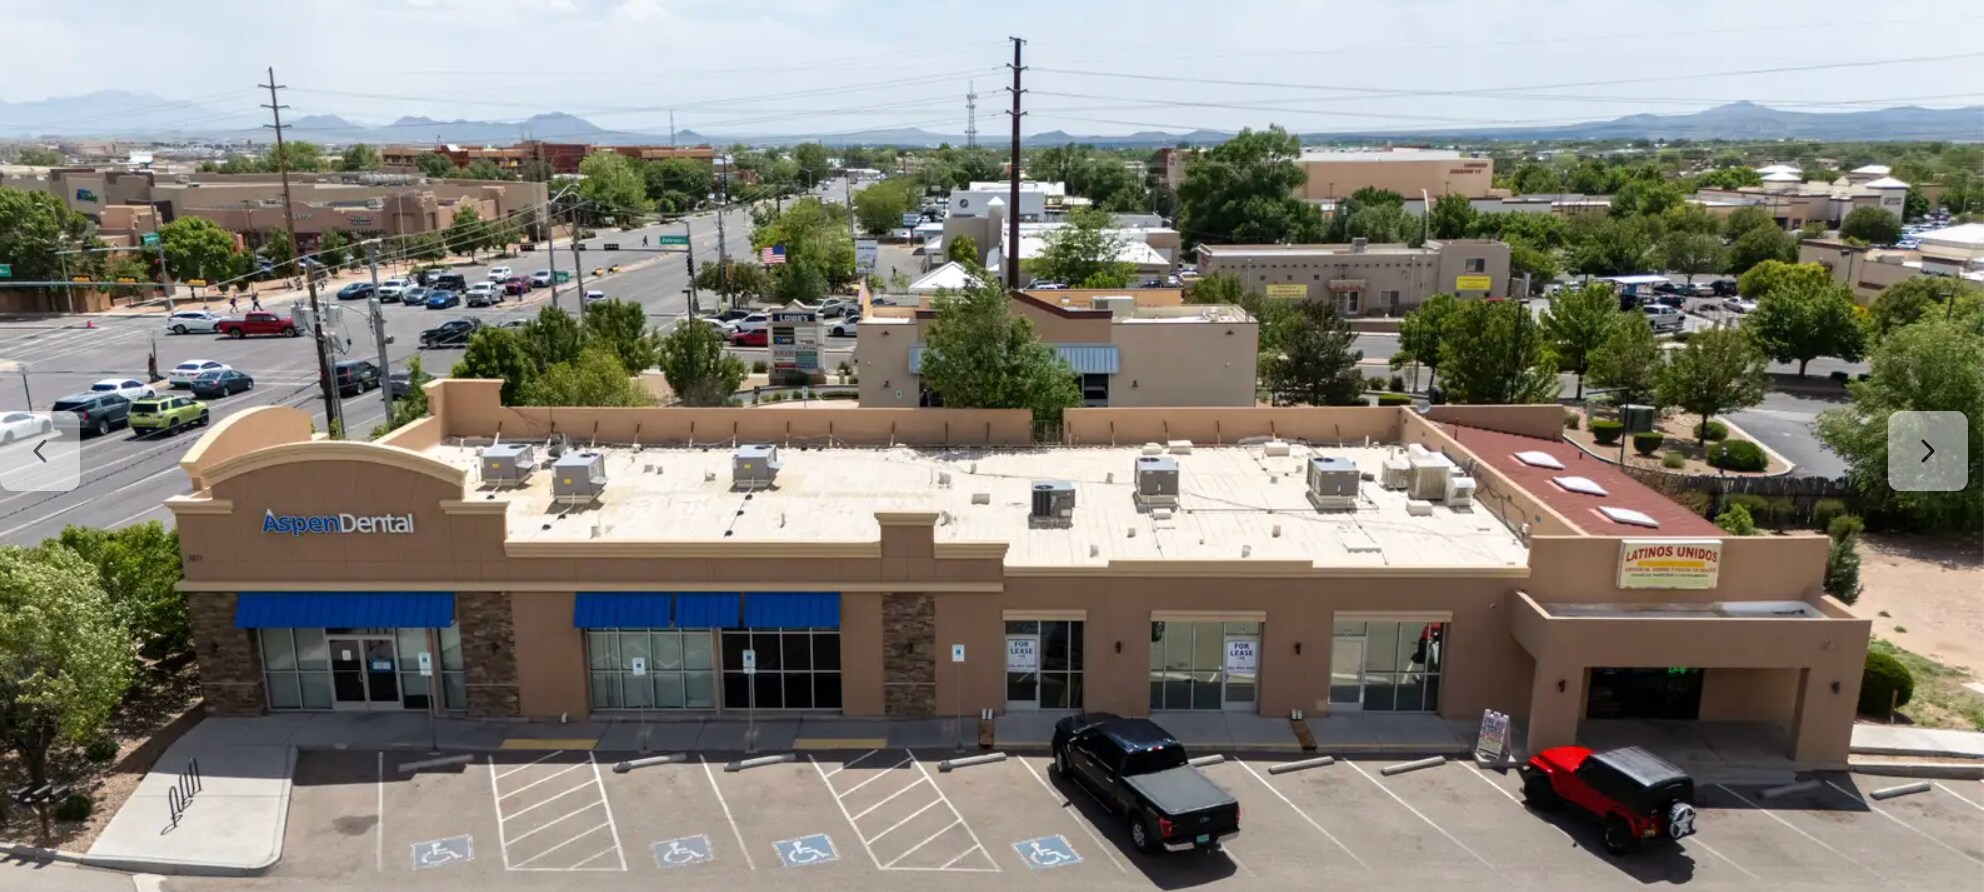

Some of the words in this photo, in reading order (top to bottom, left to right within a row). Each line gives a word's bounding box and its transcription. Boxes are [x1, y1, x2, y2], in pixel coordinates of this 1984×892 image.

[261, 508, 415, 537] AspenDental
[1625, 545, 1674, 563] LATINOS
[1676, 546, 1719, 564] UNIDOS
[1014, 640, 1030, 648] FOR
[1234, 642, 1250, 650] FOR
[1010, 647, 1033, 655] LEASE
